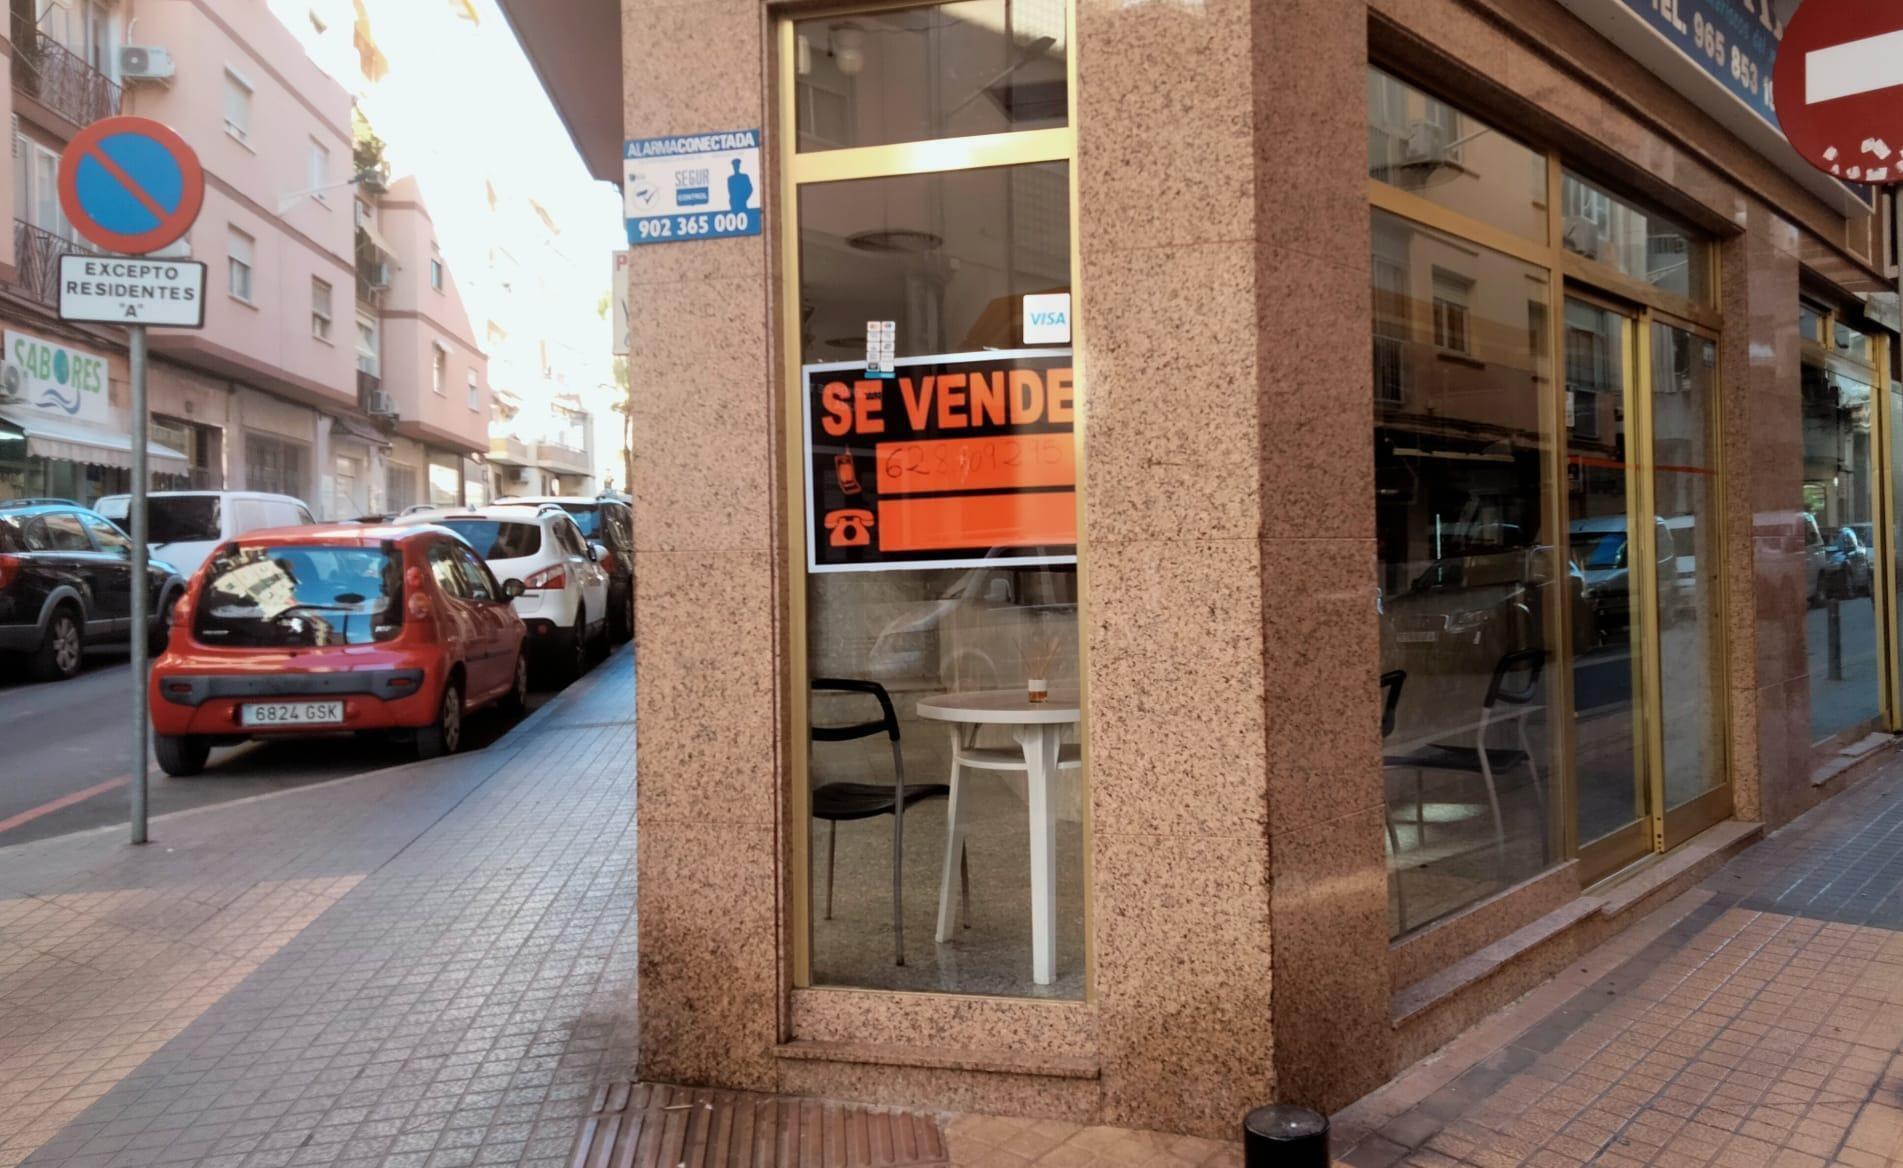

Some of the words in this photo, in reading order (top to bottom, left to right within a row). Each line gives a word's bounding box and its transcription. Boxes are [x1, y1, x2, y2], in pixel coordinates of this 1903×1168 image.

[1693, 11, 1726, 67] 965
[1730, 44, 1759, 96] 853
[627, 132, 755, 158] ALARMACONECTADA
[674, 167, 710, 187] SEGUR
[638, 217, 672, 238] 902
[677, 214, 709, 234] 365
[714, 212, 748, 232] 000
[85, 261, 179, 280] EXCEPTO
[66, 280, 195, 301] RESIDENTES
[1030, 310, 1066, 326] VISA
[14, 337, 102, 394] SABORES
[821, 380, 885, 436] SE
[898, 367, 1074, 431] VENDE
[255, 705, 299, 722] 6824
[305, 704, 337, 720] GSK
